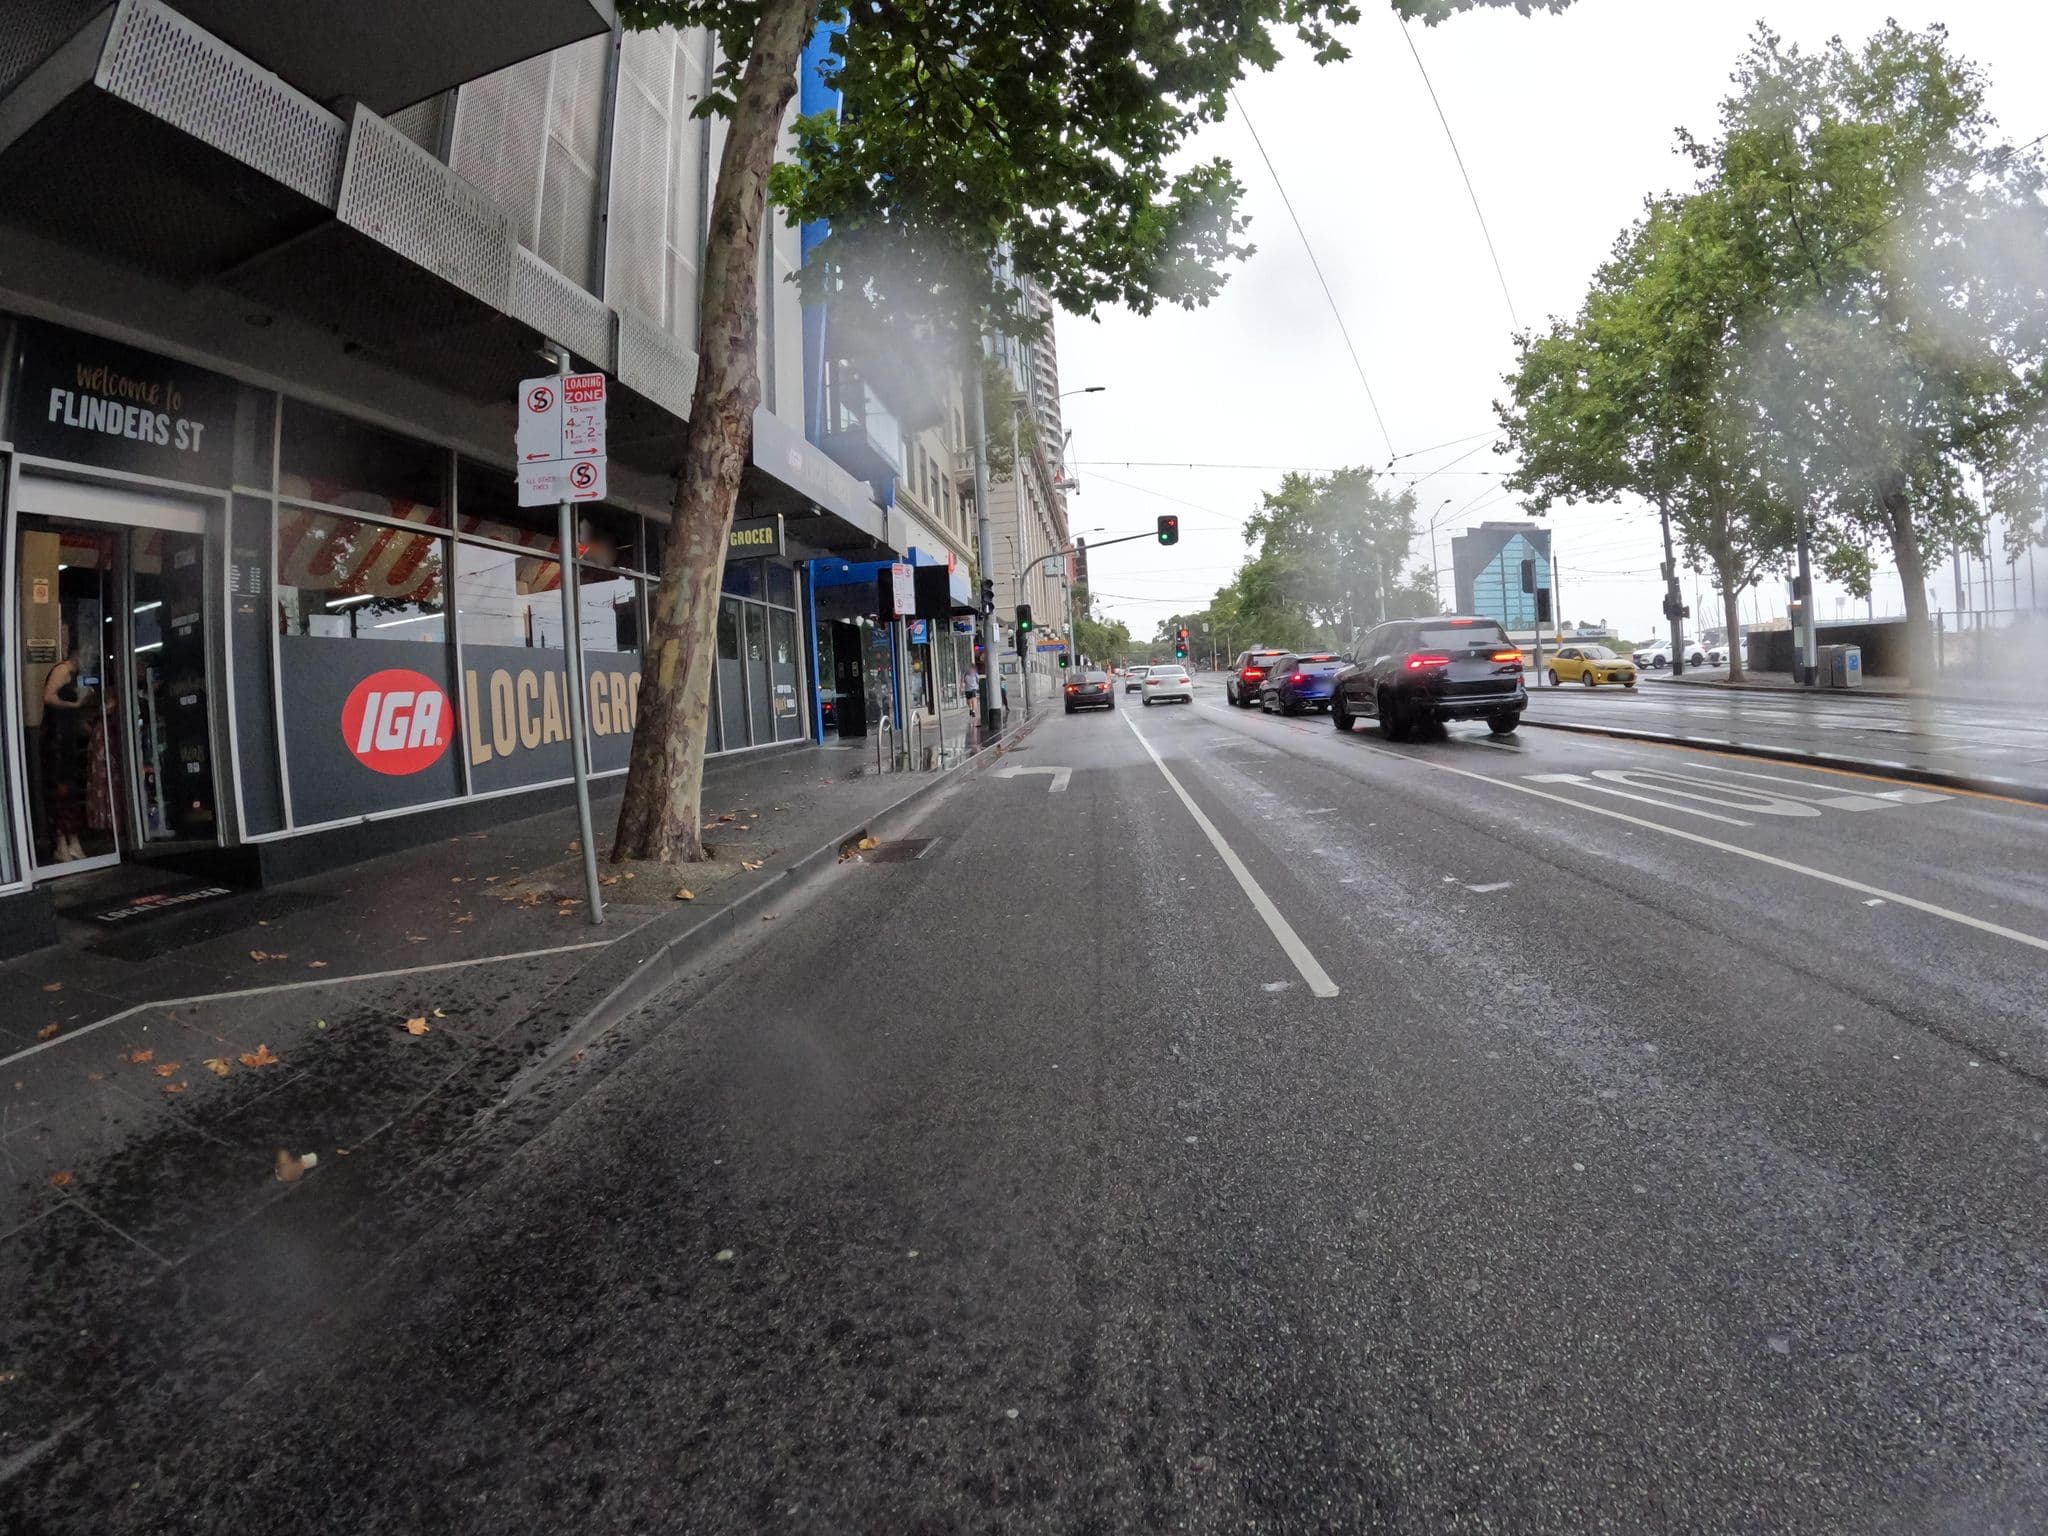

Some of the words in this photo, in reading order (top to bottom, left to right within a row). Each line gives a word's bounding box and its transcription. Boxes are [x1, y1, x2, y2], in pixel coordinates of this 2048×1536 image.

[77, 363, 160, 405] welcome
[167, 380, 182, 411] to
[565, 389, 603, 402] ZONE
[566, 376, 601, 390] LOADING
[48, 387, 170, 446] FLINDERS
[174, 418, 204, 453] ST
[569, 406, 579, 414] 15
[730, 527, 773, 546] GROCER
[357, 691, 442, 753] IGA
[1521, 763, 1957, 827] TOLL
